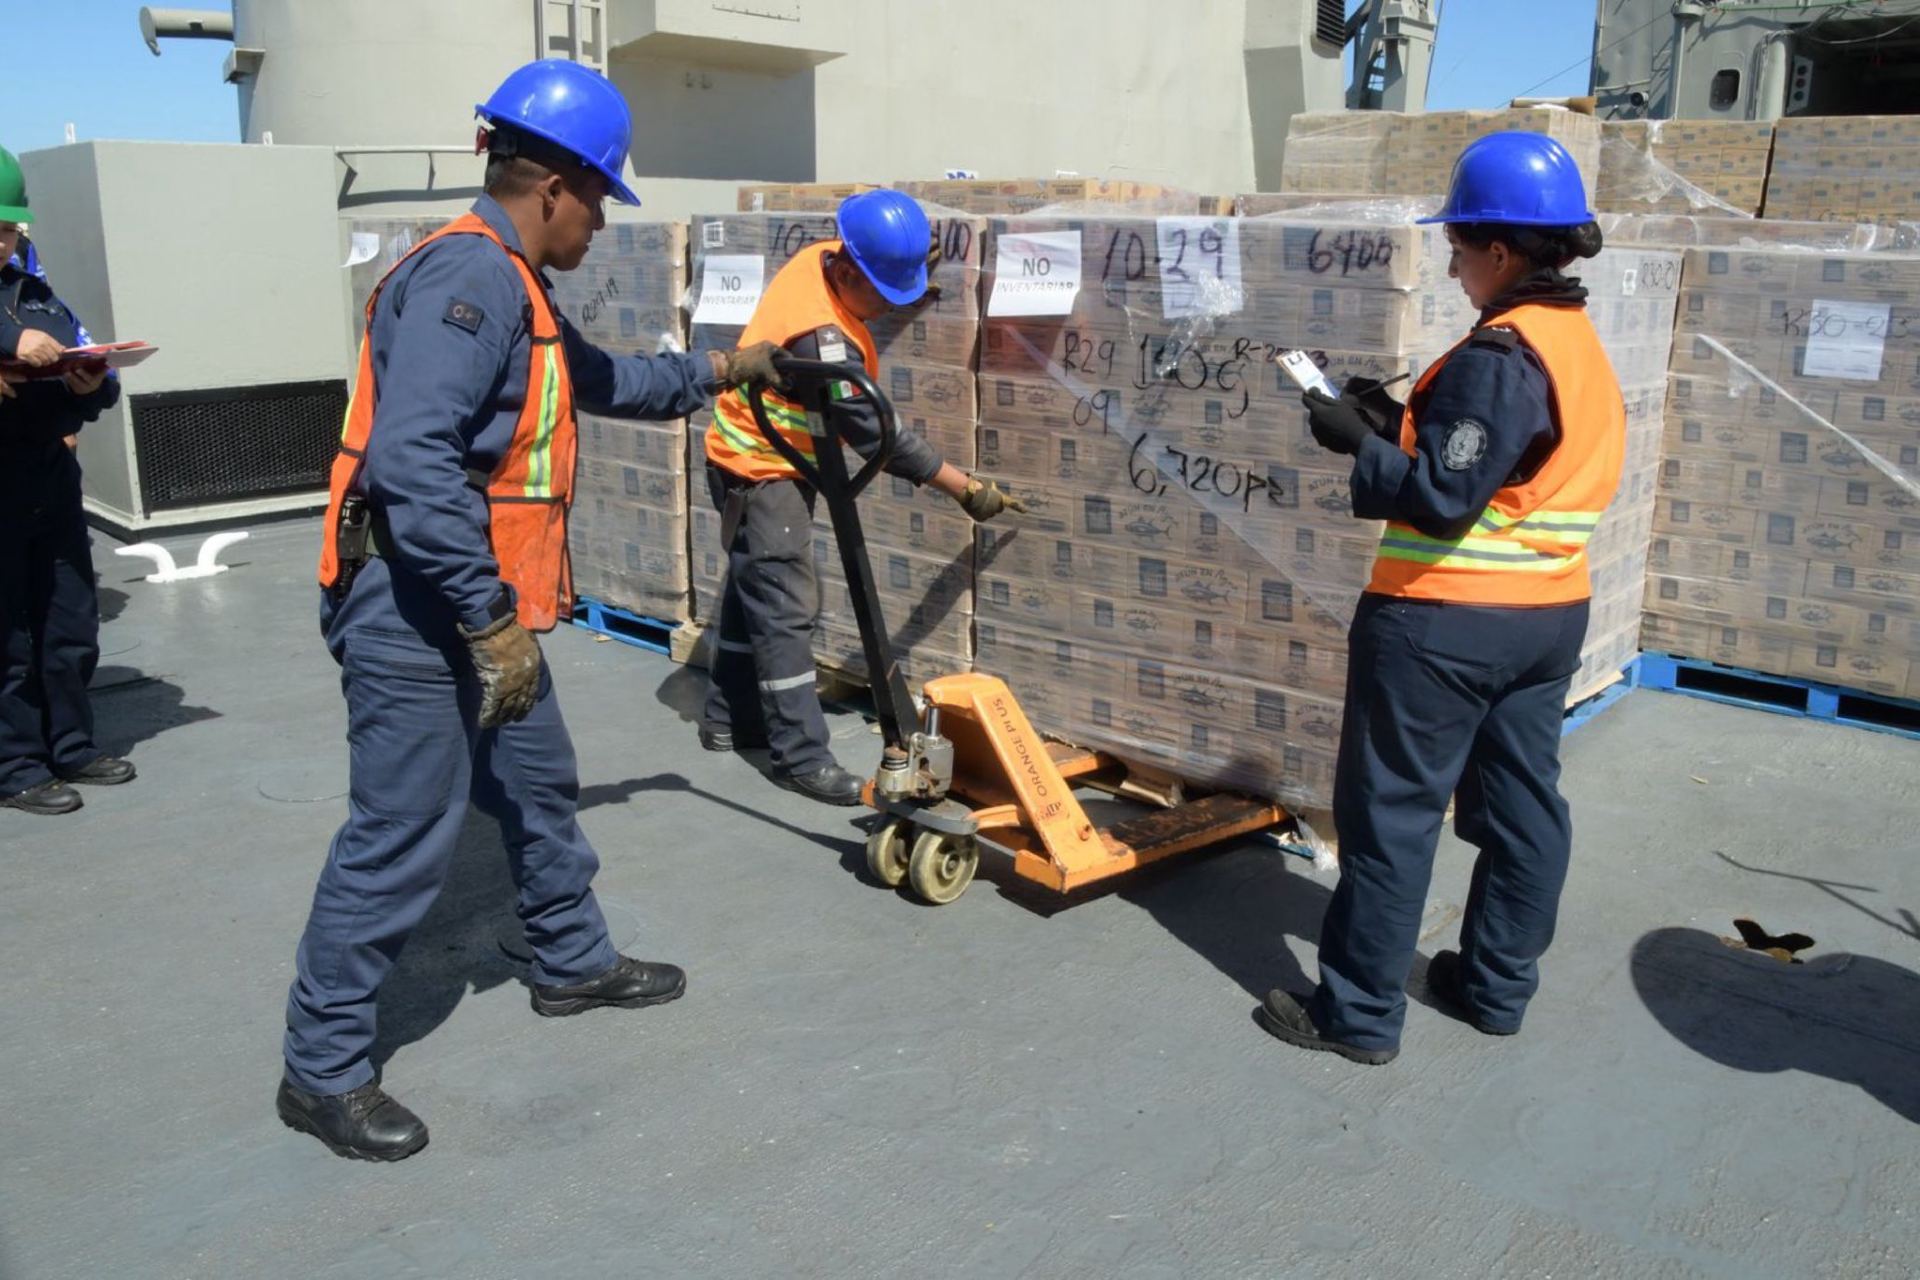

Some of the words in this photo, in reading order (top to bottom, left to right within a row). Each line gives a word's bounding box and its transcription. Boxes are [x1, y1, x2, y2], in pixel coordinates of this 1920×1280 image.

[721, 275, 742, 292] NO
[1022, 257, 1051, 276] NO
[1064, 330, 1116, 379] R29
[1012, 735, 1048, 797] ORANGE
